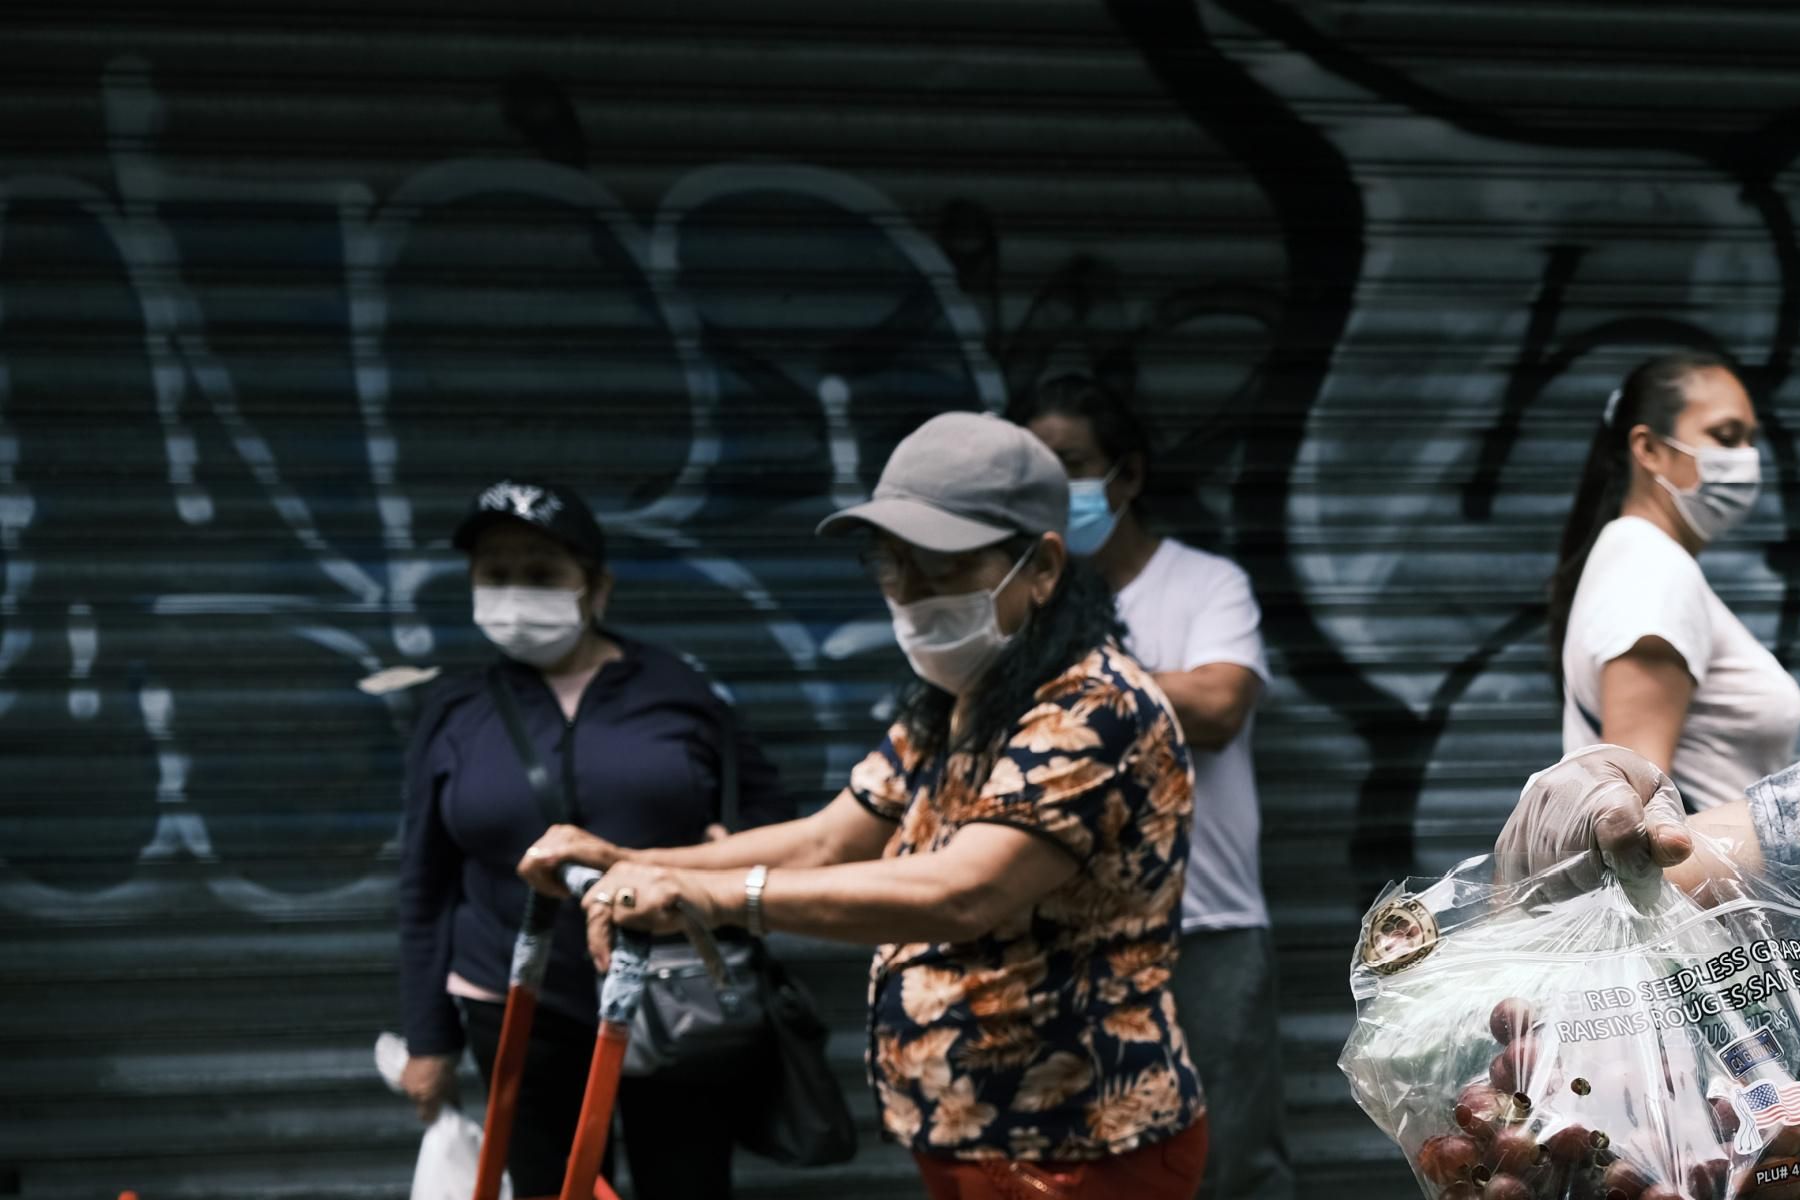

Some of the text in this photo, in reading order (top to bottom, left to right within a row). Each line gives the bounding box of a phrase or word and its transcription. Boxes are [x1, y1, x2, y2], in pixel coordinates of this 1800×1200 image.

[1586, 988, 1635, 1012] RED
[1640, 946, 1748, 1002] SEEDLESS
[1555, 1013, 1648, 1043] RAISINS
[1650, 980, 1751, 1031] ROUGES
[1730, 1055, 1745, 1071] CA
[1756, 1166, 1788, 1185] PLU#
